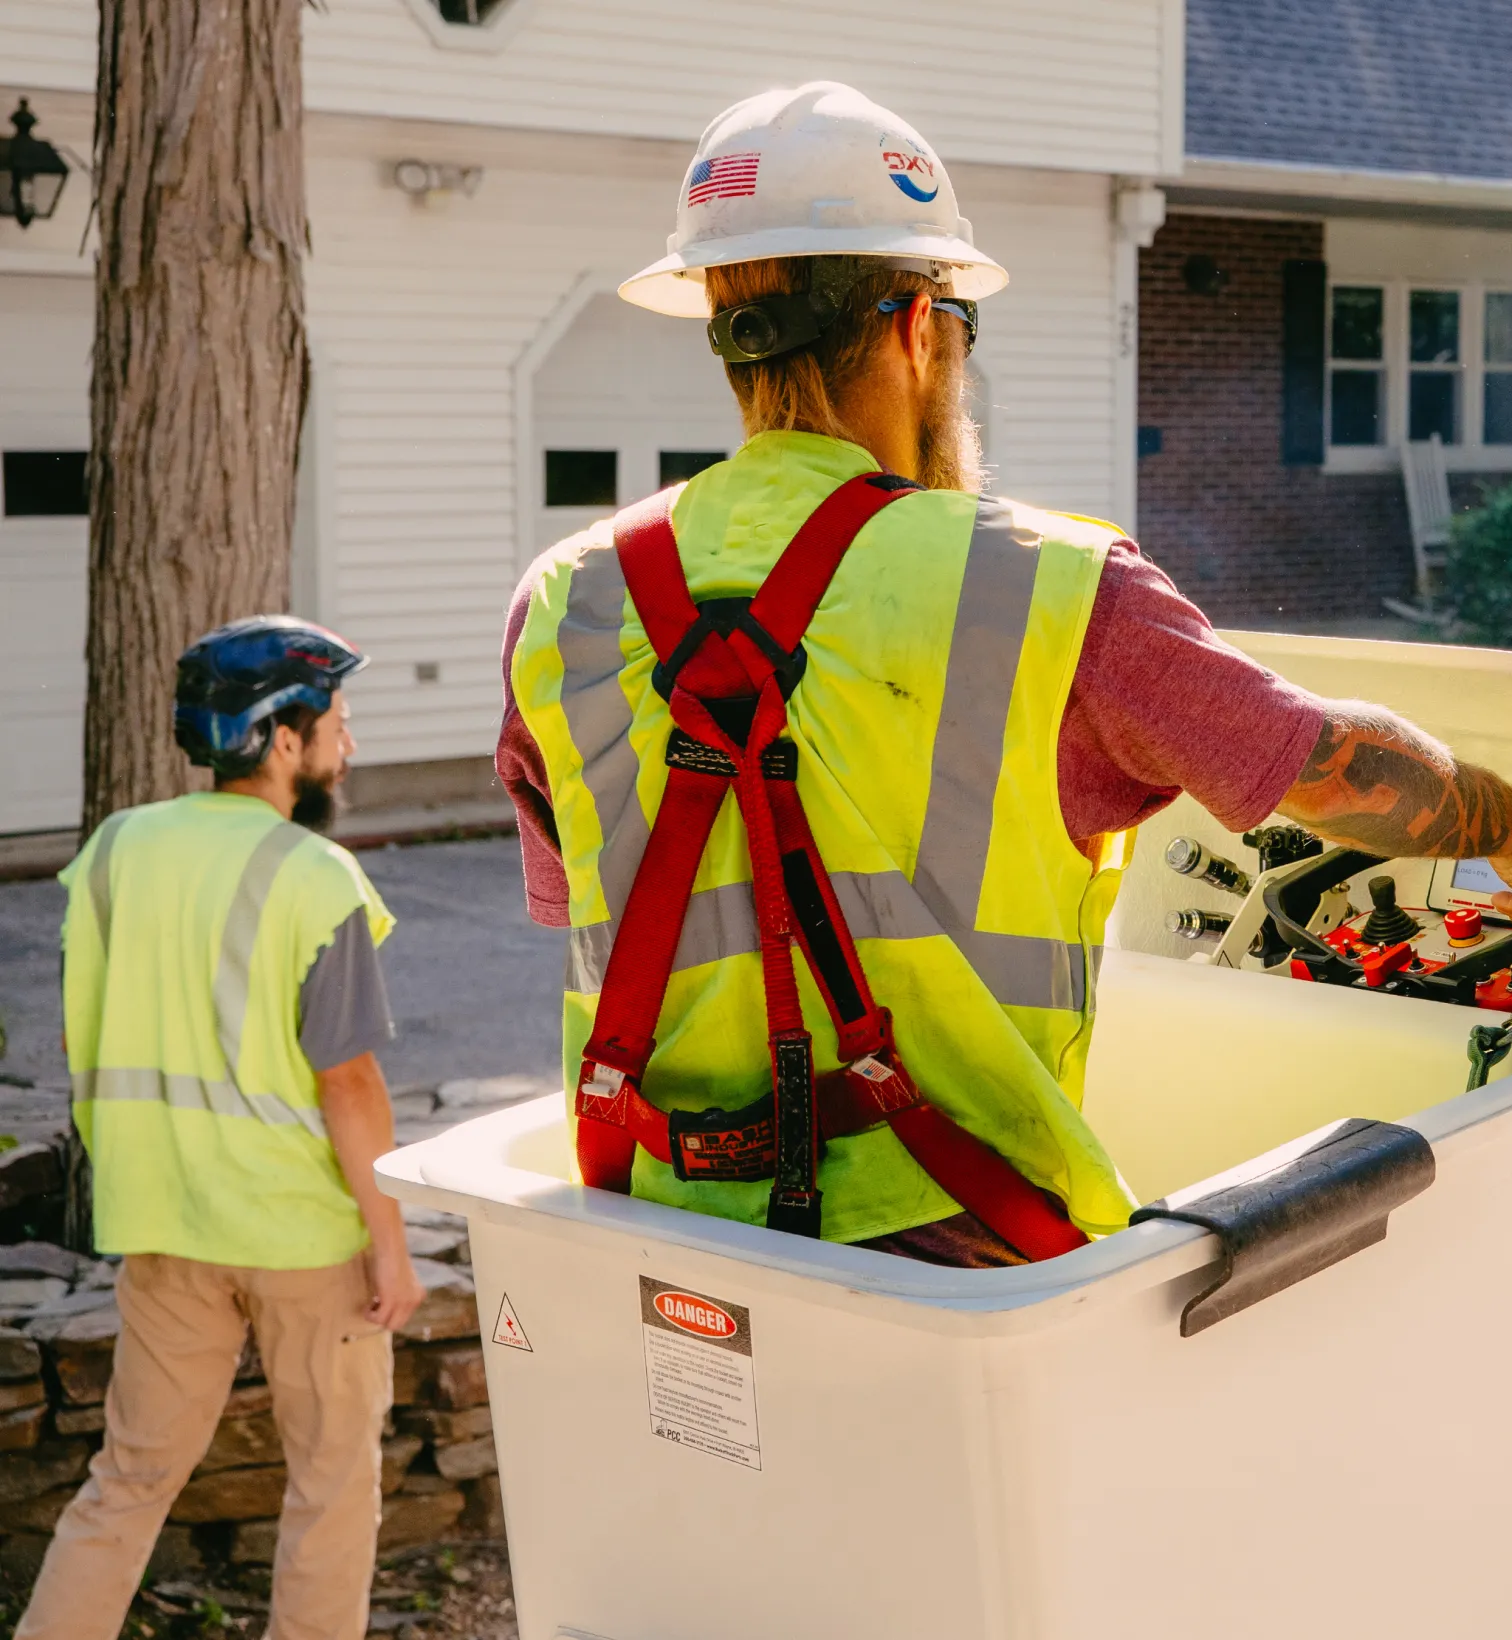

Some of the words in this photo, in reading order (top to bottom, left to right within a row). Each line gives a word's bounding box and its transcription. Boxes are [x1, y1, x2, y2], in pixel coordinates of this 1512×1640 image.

[1457, 867, 1471, 875] LOAD
[663, 1296, 728, 1333] DANGER
[667, 1429, 681, 1442] PCC
